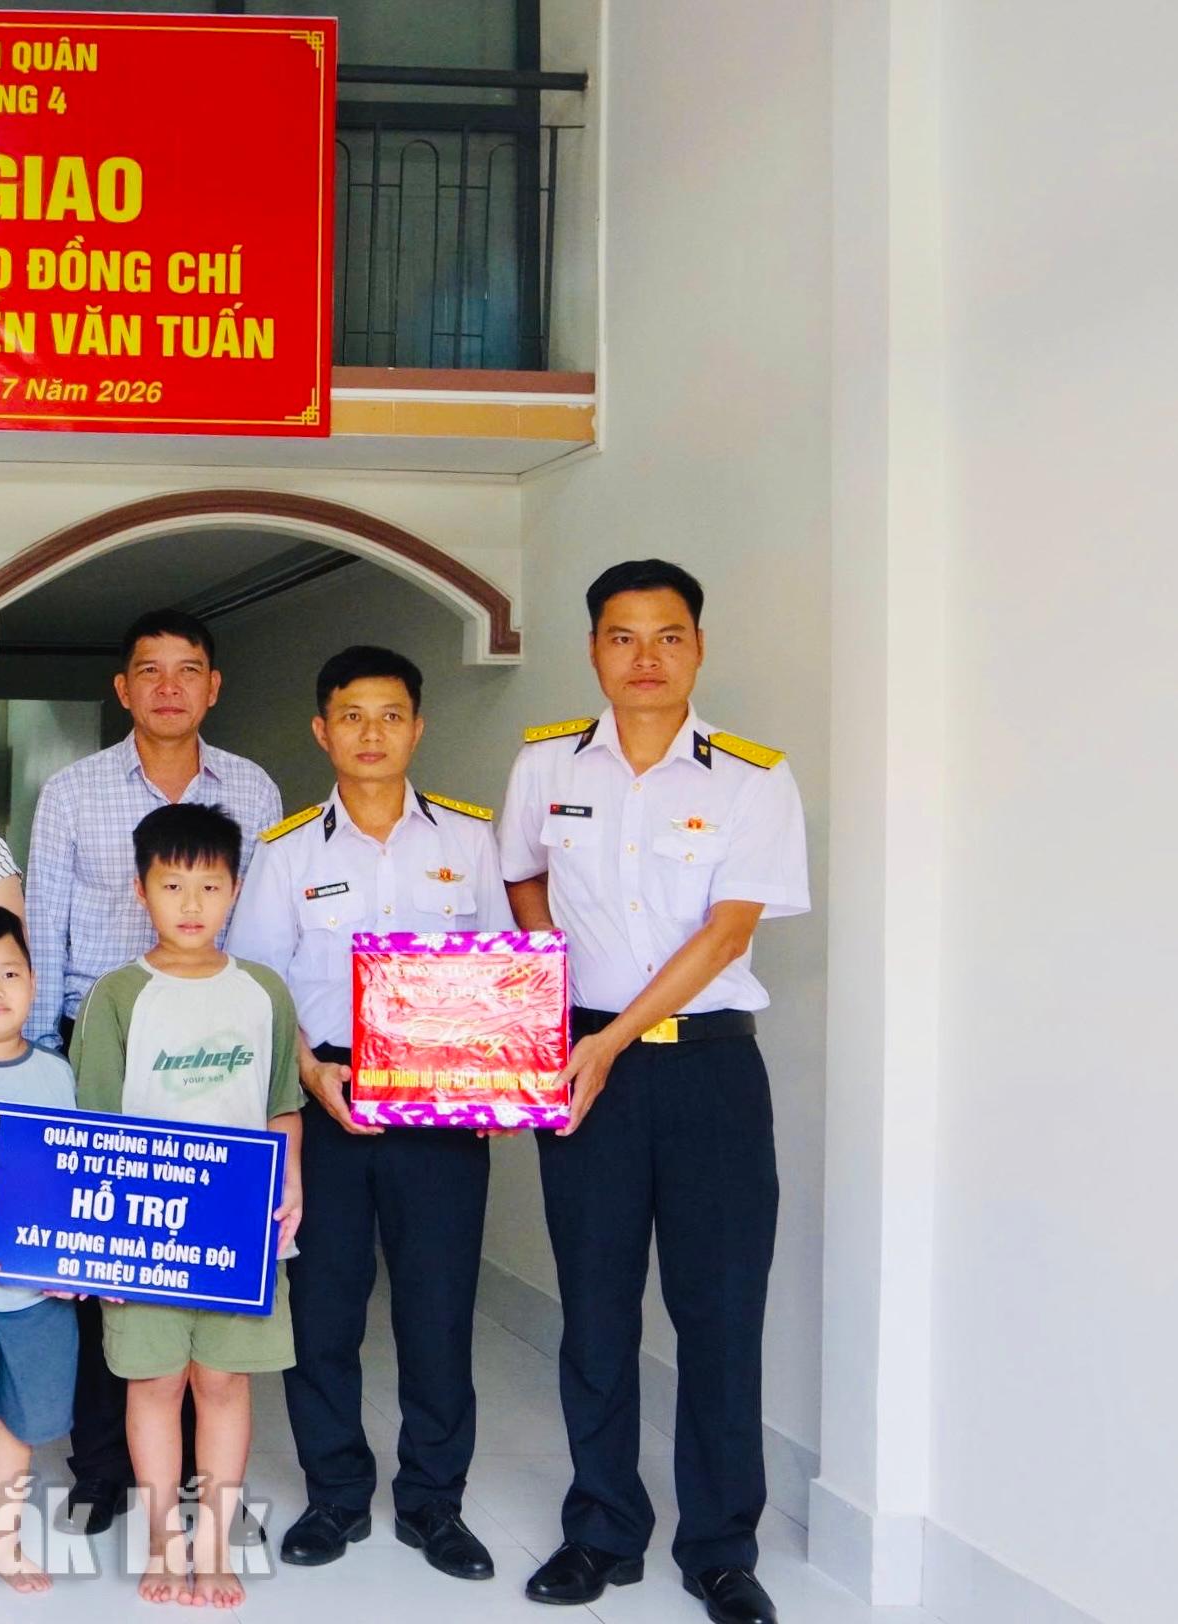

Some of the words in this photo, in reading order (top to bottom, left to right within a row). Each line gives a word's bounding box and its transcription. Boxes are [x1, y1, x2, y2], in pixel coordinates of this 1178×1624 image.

[13, 38, 97, 72] QUÂN
[49, 87, 66, 113] 4
[27, 236, 150, 292] ĐỒNG
[169, 246, 241, 293] CHÍ
[51, 306, 140, 355] VĂN
[157, 303, 273, 358] TUẤN
[3, 378, 18, 399] 7
[26, 379, 87, 400] Năm
[97, 381, 161, 402] 2026
[44, 1127, 88, 1147] QUÂN
[93, 1128, 148, 1154] CHỦNG
[152, 1133, 181, 1157] HẢI
[184, 1142, 227, 1163] QUÂN
[57, 1151, 78, 1174] BỘ
[84, 1156, 105, 1173] TƯ
[107, 1157, 148, 1179] LỆNH
[154, 1158, 195, 1183] VÙNG
[200, 1169, 209, 1185] 4
[71, 1180, 114, 1221] HỖ
[126, 1194, 188, 1235] TRỢ
[16, 1225, 51, 1247] XÂY
[56, 1231, 104, 1254] DỰNG
[110, 1237, 146, 1258] NHÀ
[152, 1238, 200, 1265] ĐỒNG
[206, 1246, 235, 1270] ĐỘI
[58, 1258, 80, 1276] 80
[84, 1260, 135, 1285] TRIỆU
[139, 1262, 189, 1289] ĐỒNG
